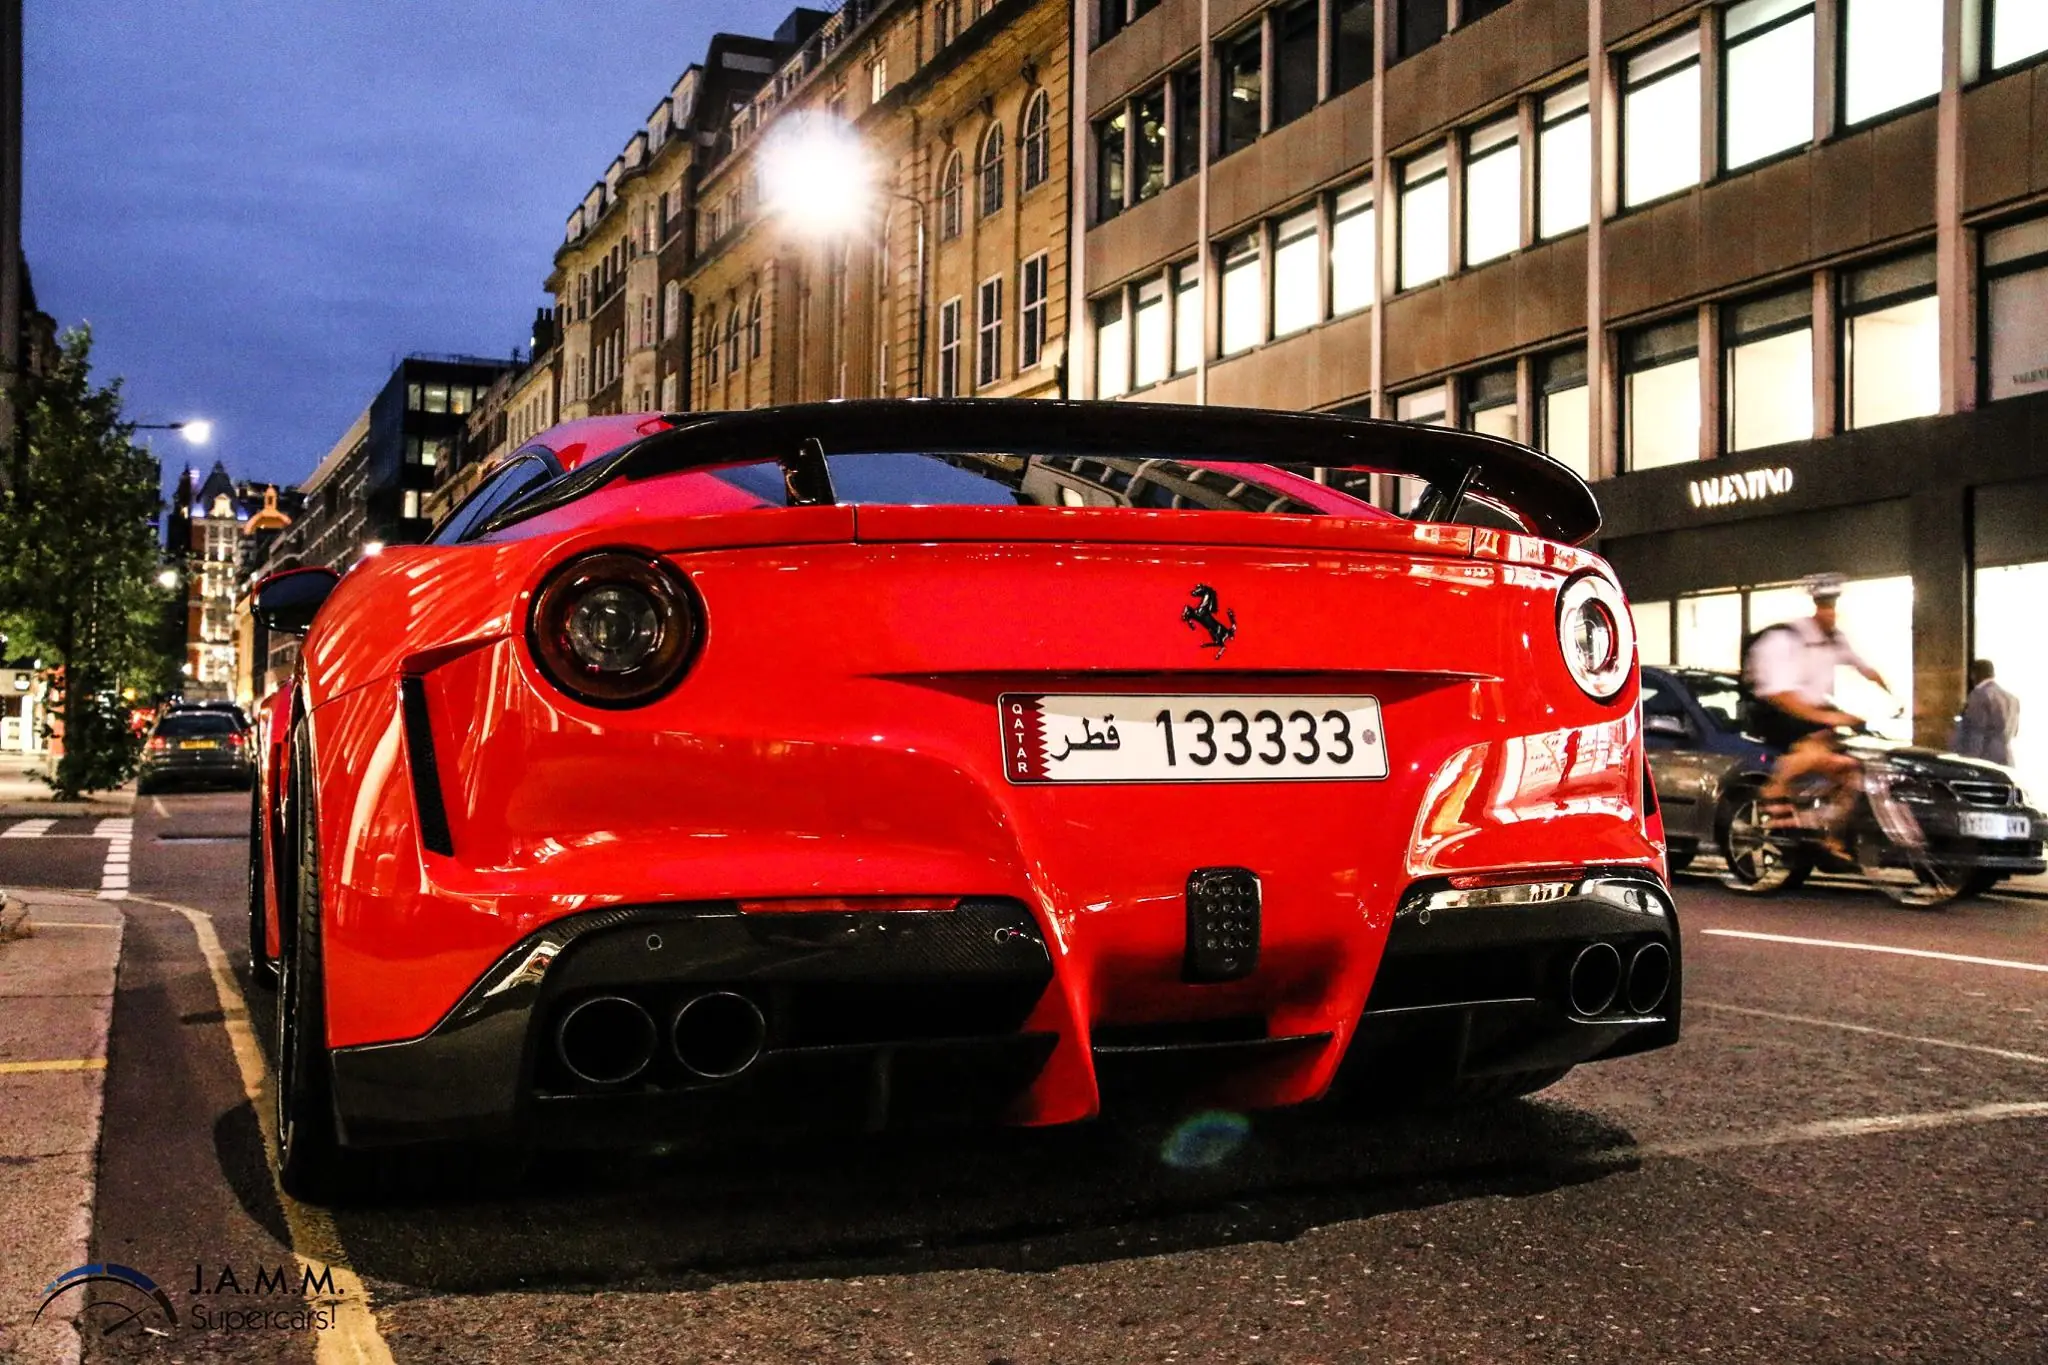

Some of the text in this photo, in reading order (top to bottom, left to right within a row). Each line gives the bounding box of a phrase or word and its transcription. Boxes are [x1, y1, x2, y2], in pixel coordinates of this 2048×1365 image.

[1689, 466, 1794, 508] VALENTINO
[1012, 703, 1028, 773] QATAR
[1050, 713, 1121, 761] قطر
[1155, 709, 1355, 767] 133333
